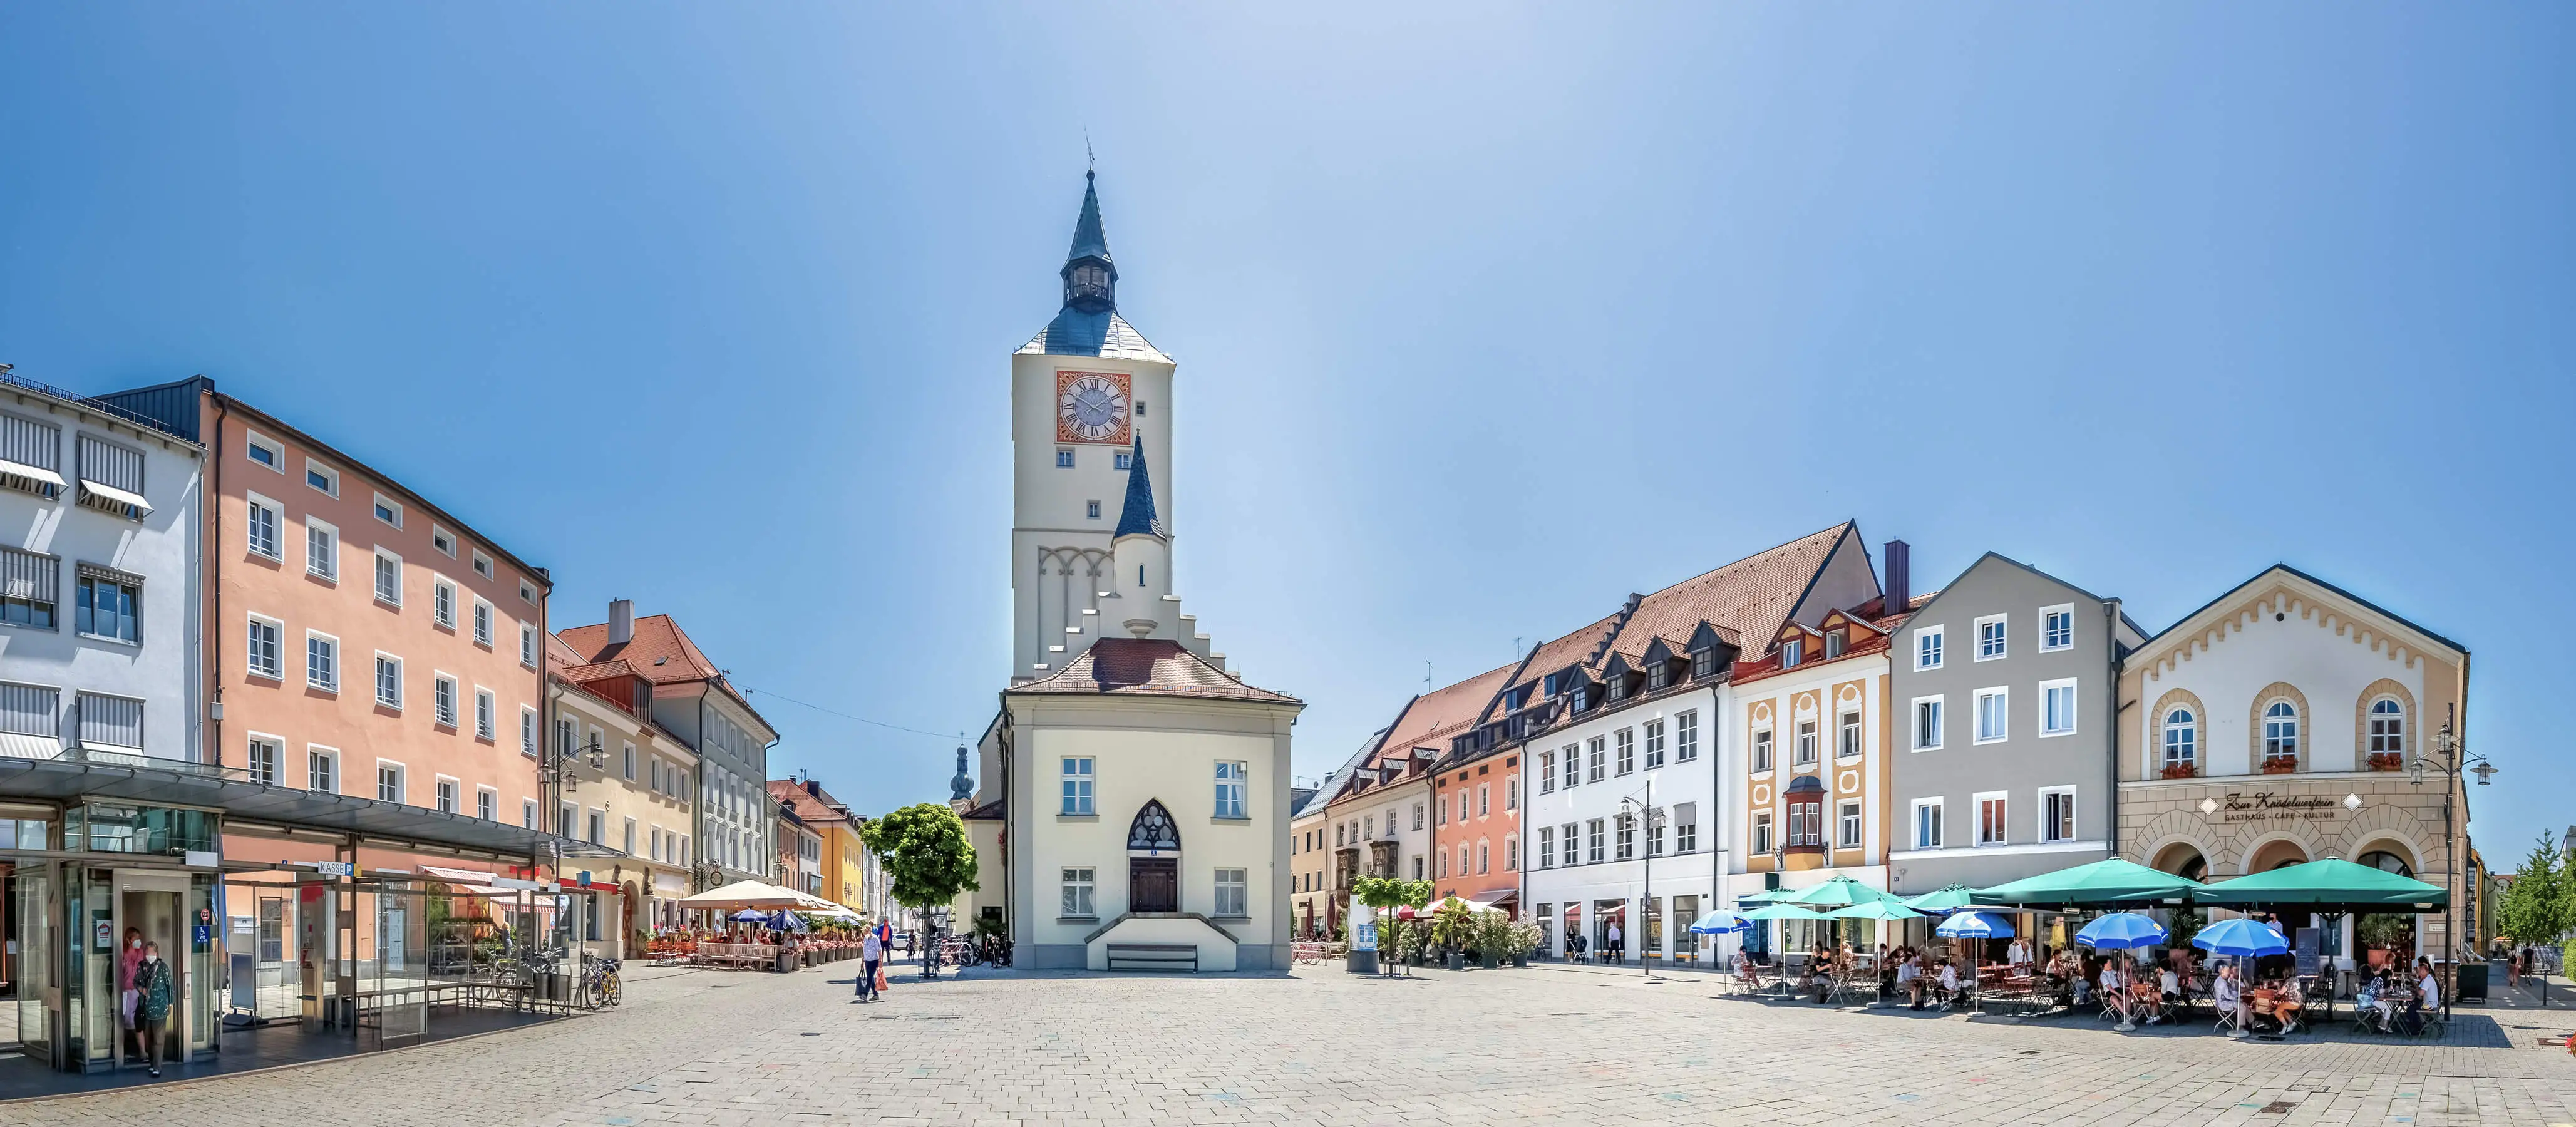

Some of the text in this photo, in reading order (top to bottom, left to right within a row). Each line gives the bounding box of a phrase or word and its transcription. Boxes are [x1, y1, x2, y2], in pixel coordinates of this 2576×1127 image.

[1077, 381, 1087, 392] XI
[1090, 379, 1099, 389] XII
[1104, 383, 1111, 392] I
[1110, 393, 1121, 401] II
[1065, 413, 1078, 426] VIII
[1076, 423, 1086, 435] VII
[1090, 426, 1100, 436] VI
[1104, 425, 1112, 435] V
[2224, 792, 2336, 811] Zur Knödelwerferin
[321, 862, 352, 874] KASSE P
